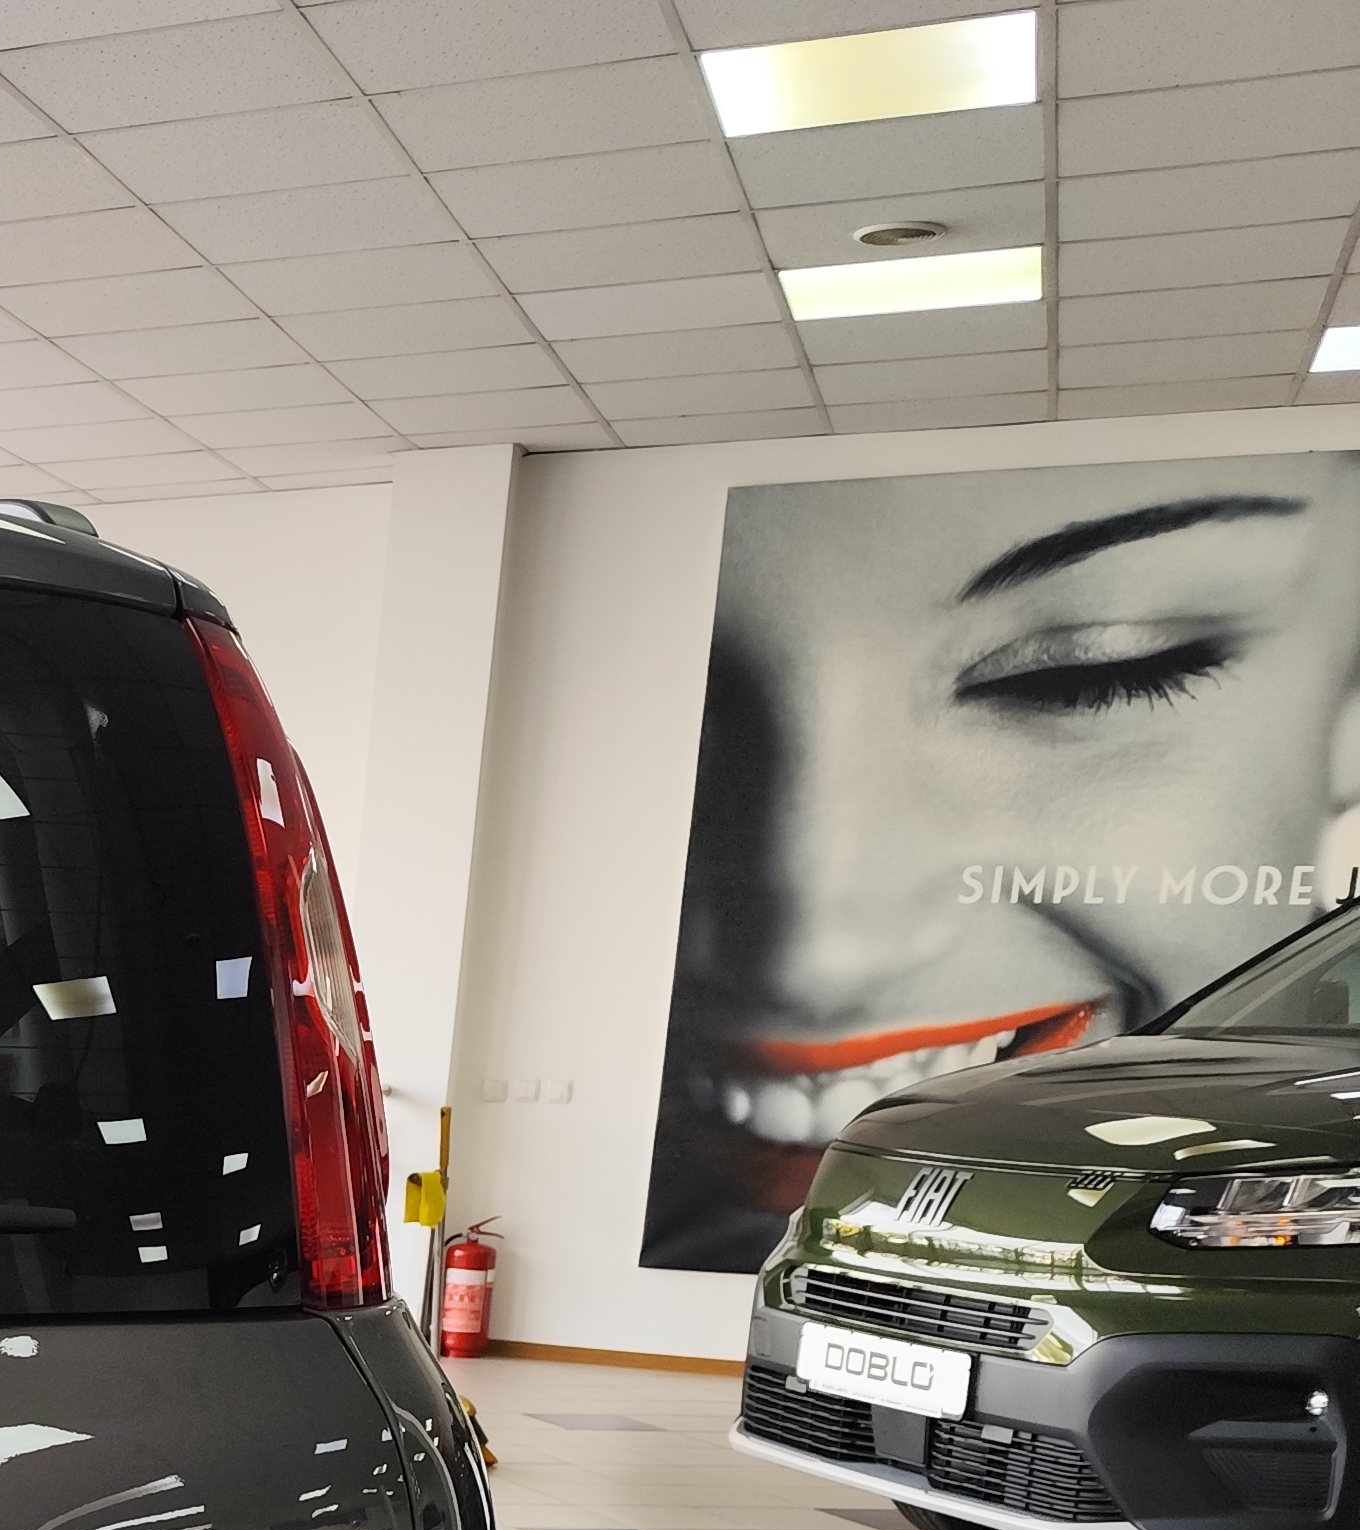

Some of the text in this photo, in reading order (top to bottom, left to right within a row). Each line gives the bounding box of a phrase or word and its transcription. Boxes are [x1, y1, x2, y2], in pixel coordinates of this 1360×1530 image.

[957, 864, 1359, 906] SIMPLY MORE J
[893, 1166, 975, 1228] FIAT
[825, 1342, 935, 1391] DOBLO
